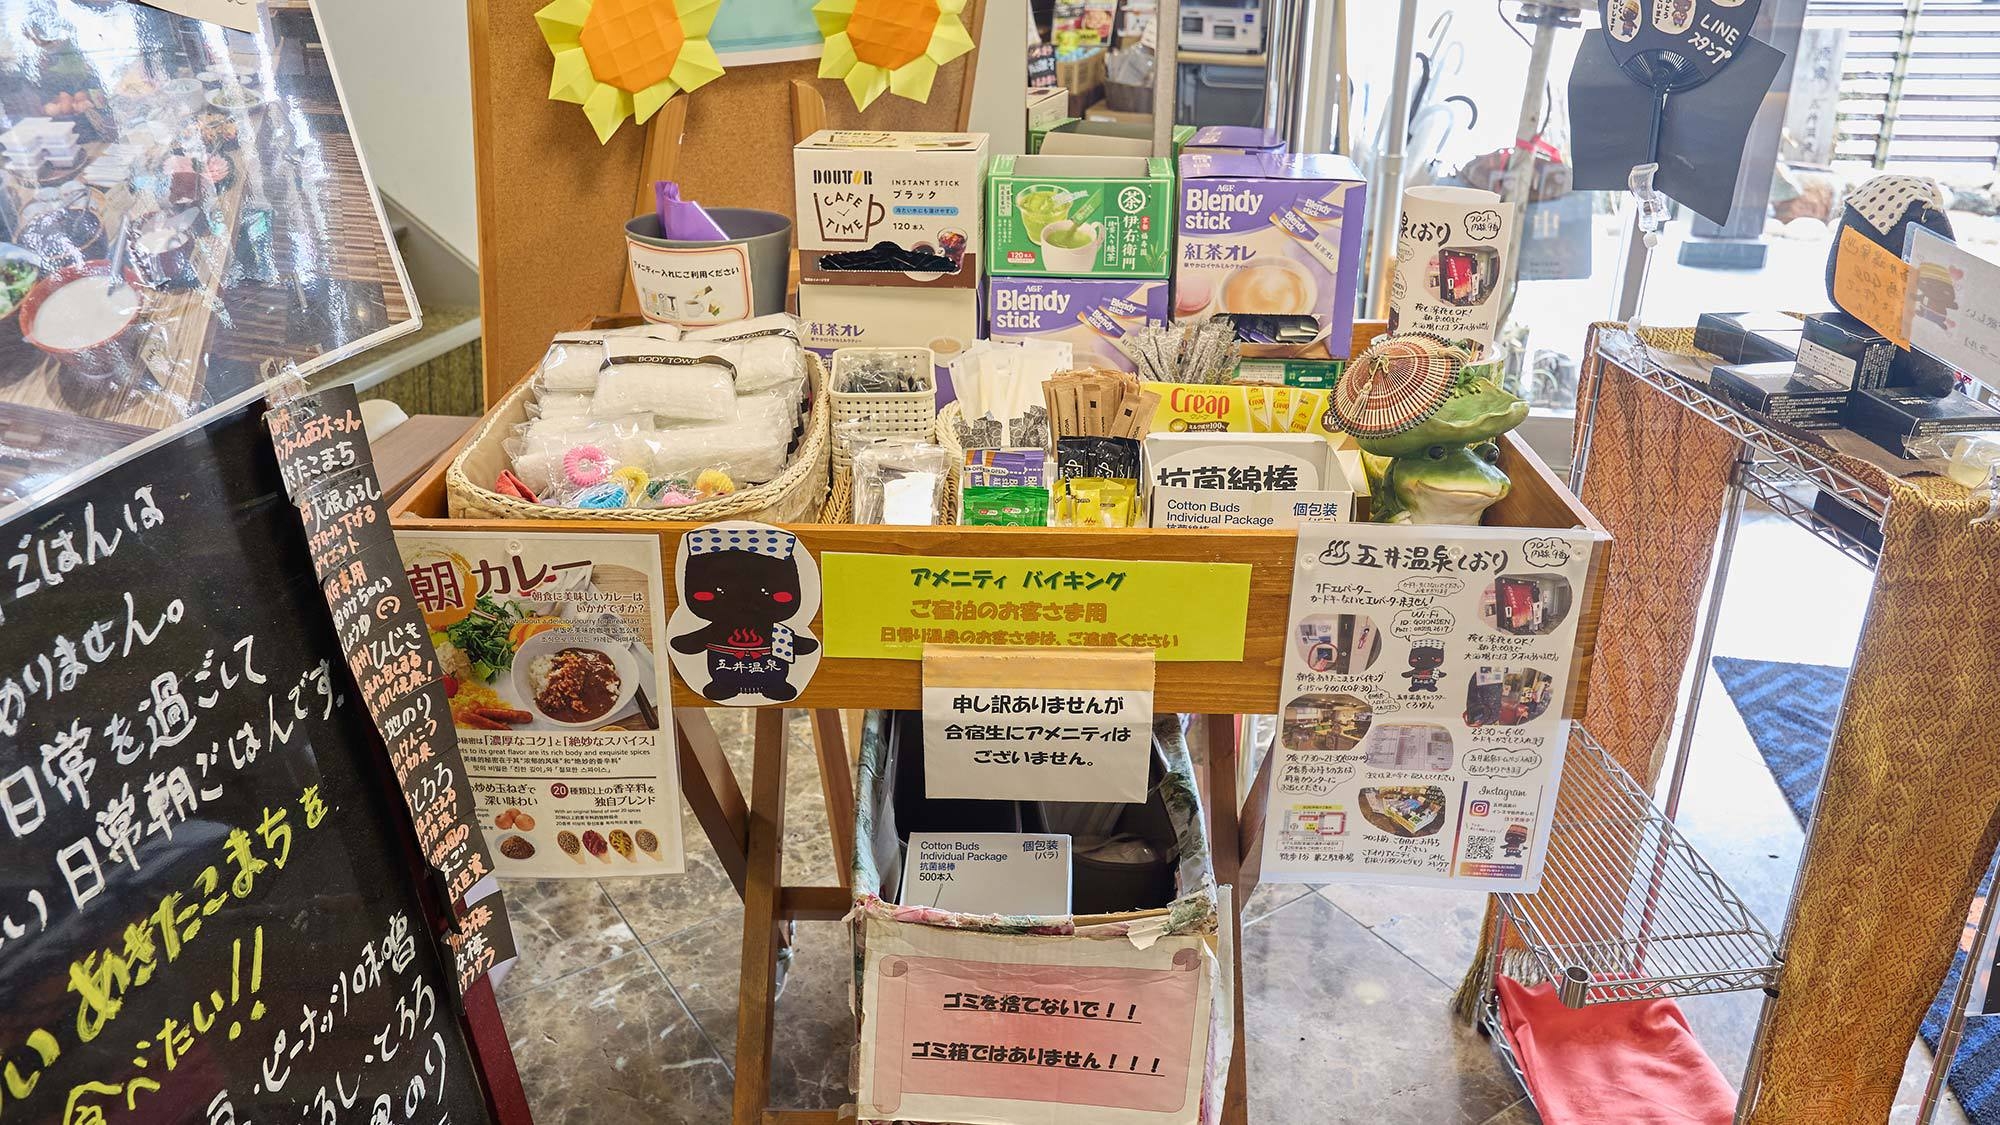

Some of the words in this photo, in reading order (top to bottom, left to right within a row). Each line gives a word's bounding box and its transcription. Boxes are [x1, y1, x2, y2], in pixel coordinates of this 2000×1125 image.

[1700, 13, 1740, 46] LINE
[1687, 31, 1733, 64] スタンプ
[824, 192, 863, 208] CAFE
[893, 190, 936, 200] ブラック
[1122, 189, 1142, 210] 茶
[1186, 189, 1264, 215] Blendy
[1304, 198, 1332, 214] Blendy
[825, 217, 864, 236] TIME
[893, 222, 925, 231] 120本入
[1185, 212, 1232, 230] stick
[1285, 210, 1307, 234] Blendy
[1122, 215, 1138, 271] 伊右衛門
[1184, 243, 1256, 261] 紅茶オレ
[634, 261, 740, 279] アメニティー入れにご利用ください
[996, 290, 1071, 315] Blendy
[1111, 297, 1136, 313] Blendy
[996, 311, 1041, 328] stick
[1091, 309, 1115, 331] Blendy
[810, 322, 865, 337] 紅茶オレ
[1171, 387, 1230, 420] Creap
[1273, 400, 1290, 410] Creap
[991, 467, 1006, 475] OPEN
[1167, 500, 1207, 512] Cotton
[1209, 501, 1240, 513] Buds
[1293, 502, 1338, 517] 個包装
[1166, 511, 1221, 523] Individual
[1224, 514, 1274, 527] Package
[7, 484, 165, 598] ごはんは
[1352, 543, 1509, 575] 五井温泉しおり
[406, 554, 593, 612] 朝カレー
[910, 567, 1008, 590] アメニティ
[1022, 569, 1127, 591] バイキング
[531, 591, 643, 602] 朝食に美味しいカレーは
[576, 604, 645, 614] いかがですか?
[910, 599, 1108, 624] ご宿泊のお客さま用
[1411, 610, 1439, 619] Wi-Fi
[880, 626, 1179, 649] 日帰り温泉のお客さまは、ご遠慮ください
[369, 622, 422, 670] ひじき
[715, 658, 782, 674] 五井温泉
[952, 695, 1124, 715] 申し訳ありませんが
[1, 634, 268, 838] 日常を過ごして
[944, 724, 1132, 743] 合宿生にアメニティは
[973, 748, 1097, 767] ございません。
[411, 762, 454, 813] とろろ
[474, 783, 536, 795] 炒め玉ねぎで
[553, 785, 567, 796] 20
[570, 784, 655, 795] 種類以上の香辛料を
[1478, 785, 1528, 801] Instagram
[484, 795, 538, 806] 深い味わい
[594, 796, 656, 807] 独自ブレンド
[920, 840, 952, 851] Cotton
[954, 841, 980, 851] Buds
[1022, 839, 1059, 852] 個包装
[920, 851, 965, 862] Individual
[967, 852, 1008, 863] Package
[1034, 851, 1059, 860] (バラ)
[919, 862, 956, 872] 抗菌綿棒
[919, 872, 954, 882] 500本入
